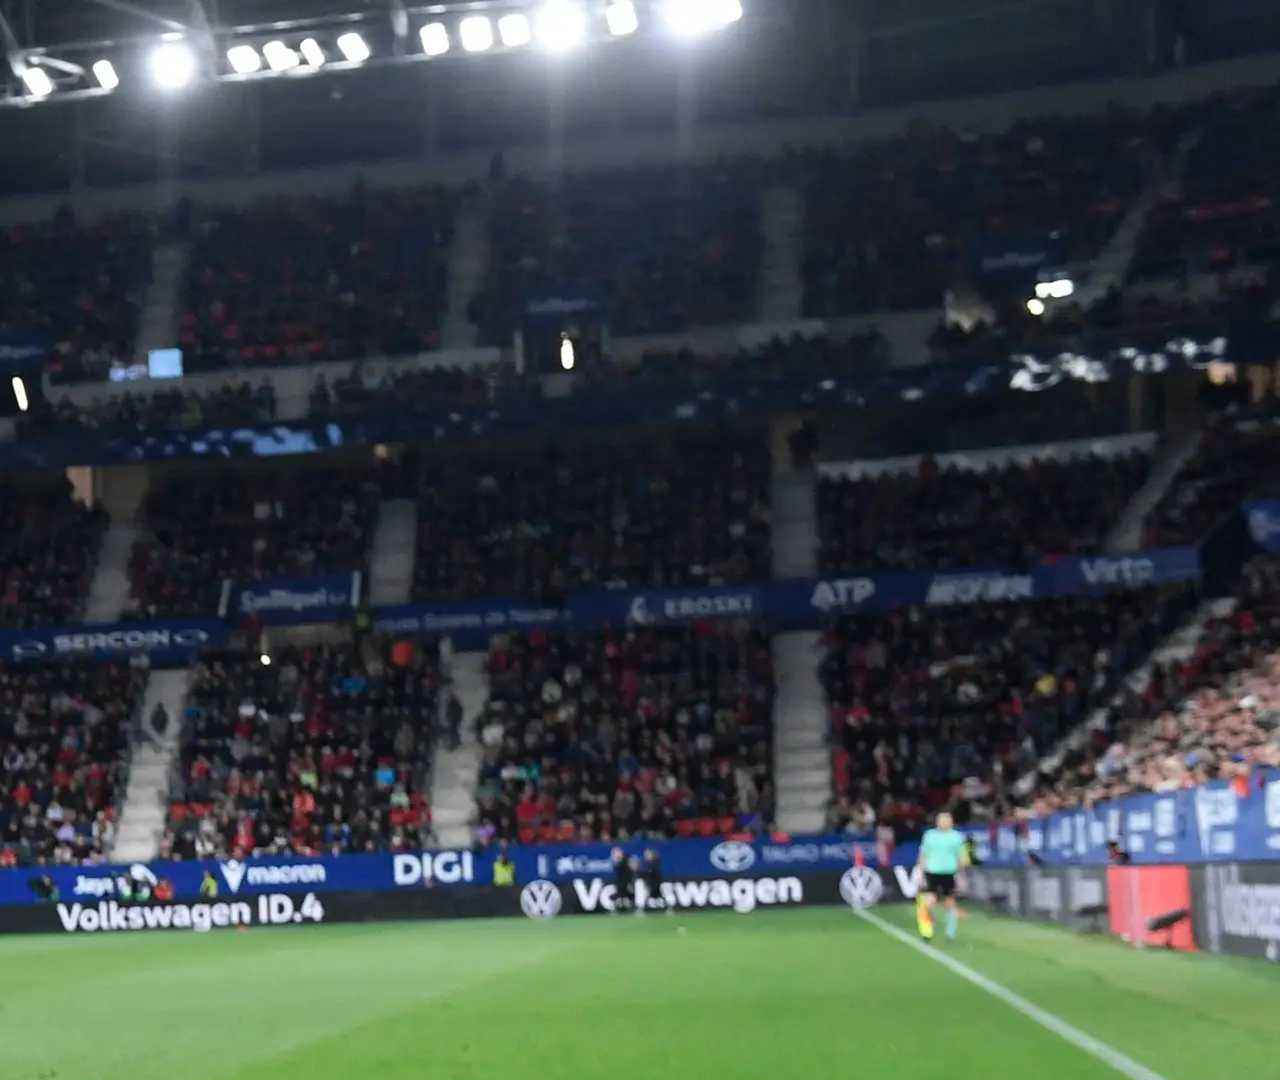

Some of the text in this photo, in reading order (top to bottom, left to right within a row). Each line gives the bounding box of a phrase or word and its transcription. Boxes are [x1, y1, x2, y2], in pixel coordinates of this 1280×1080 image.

[810, 577, 876, 608] ATP
[246, 863, 327, 886] macron
[393, 851, 474, 887] DIGI
[56, 892, 325, 933] Volkswagen ID.4
